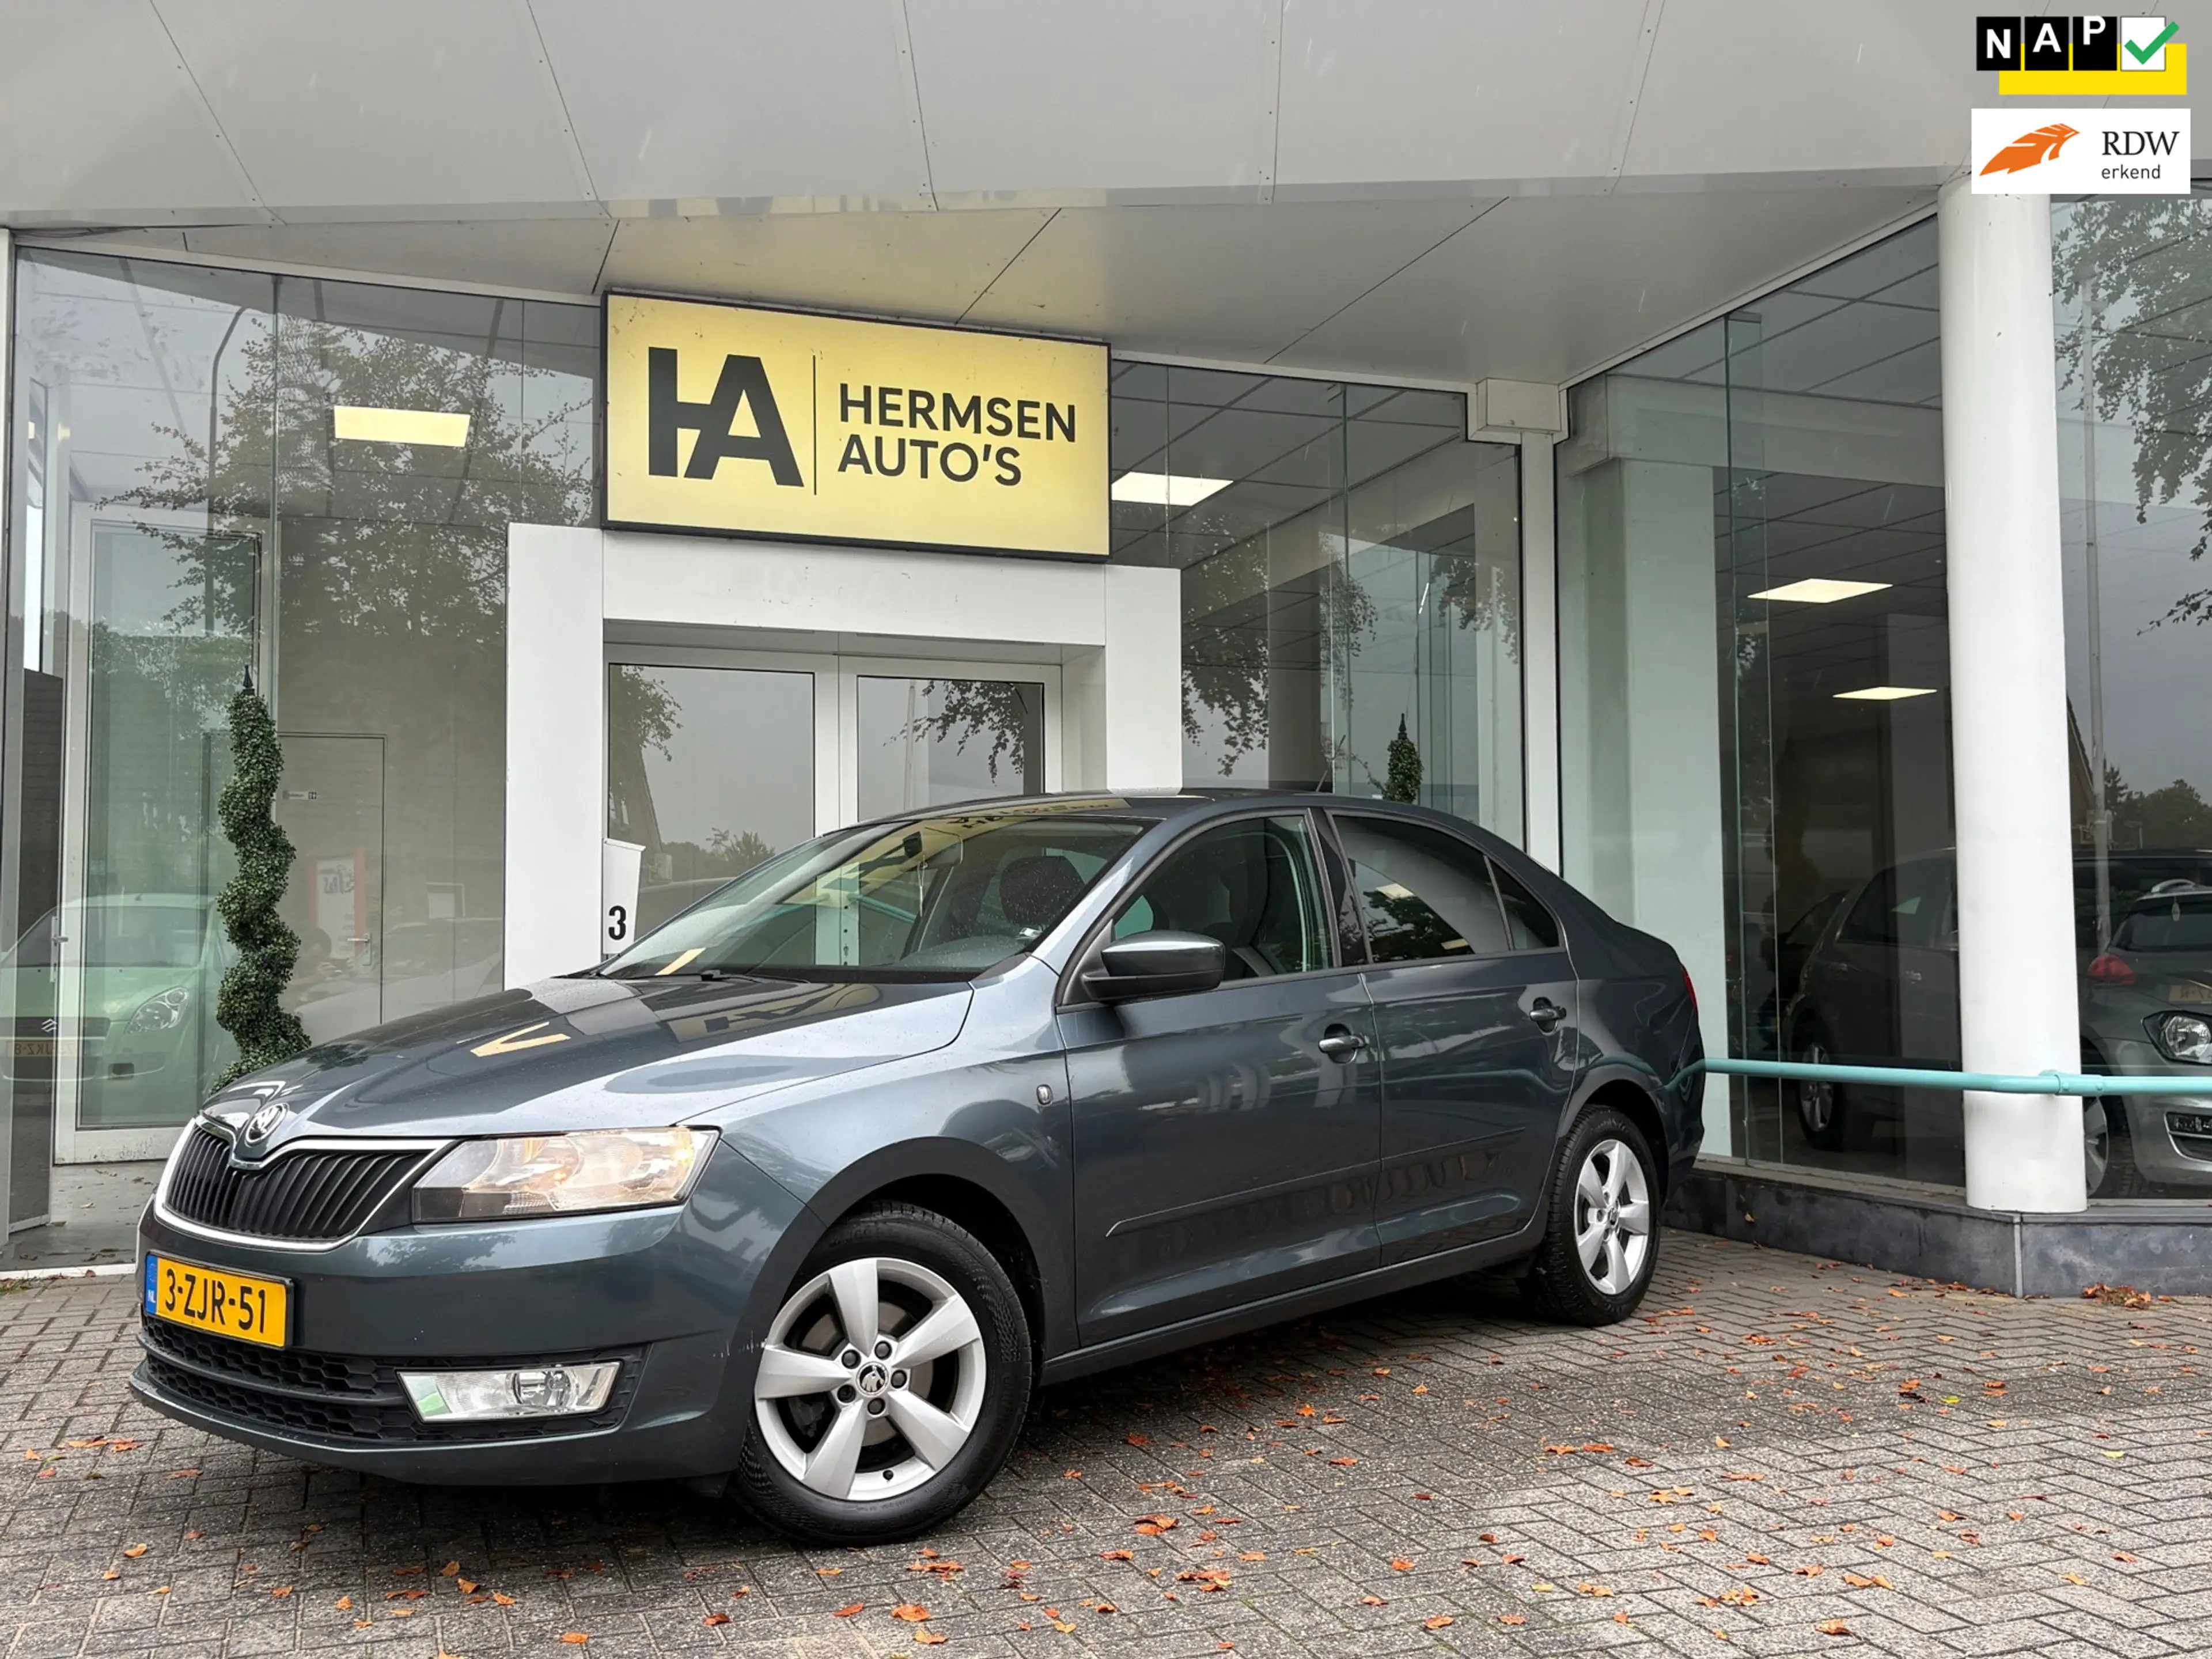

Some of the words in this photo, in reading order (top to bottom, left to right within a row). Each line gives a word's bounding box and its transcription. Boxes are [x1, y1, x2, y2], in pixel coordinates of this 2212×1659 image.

[649, 346, 804, 487] HA
[839, 382, 1076, 442] HERMSEN
[837, 433, 1022, 487] AUTO'S
[608, 905, 626, 940] 3
[165, 1268, 266, 1333] 3-ZJR-51
